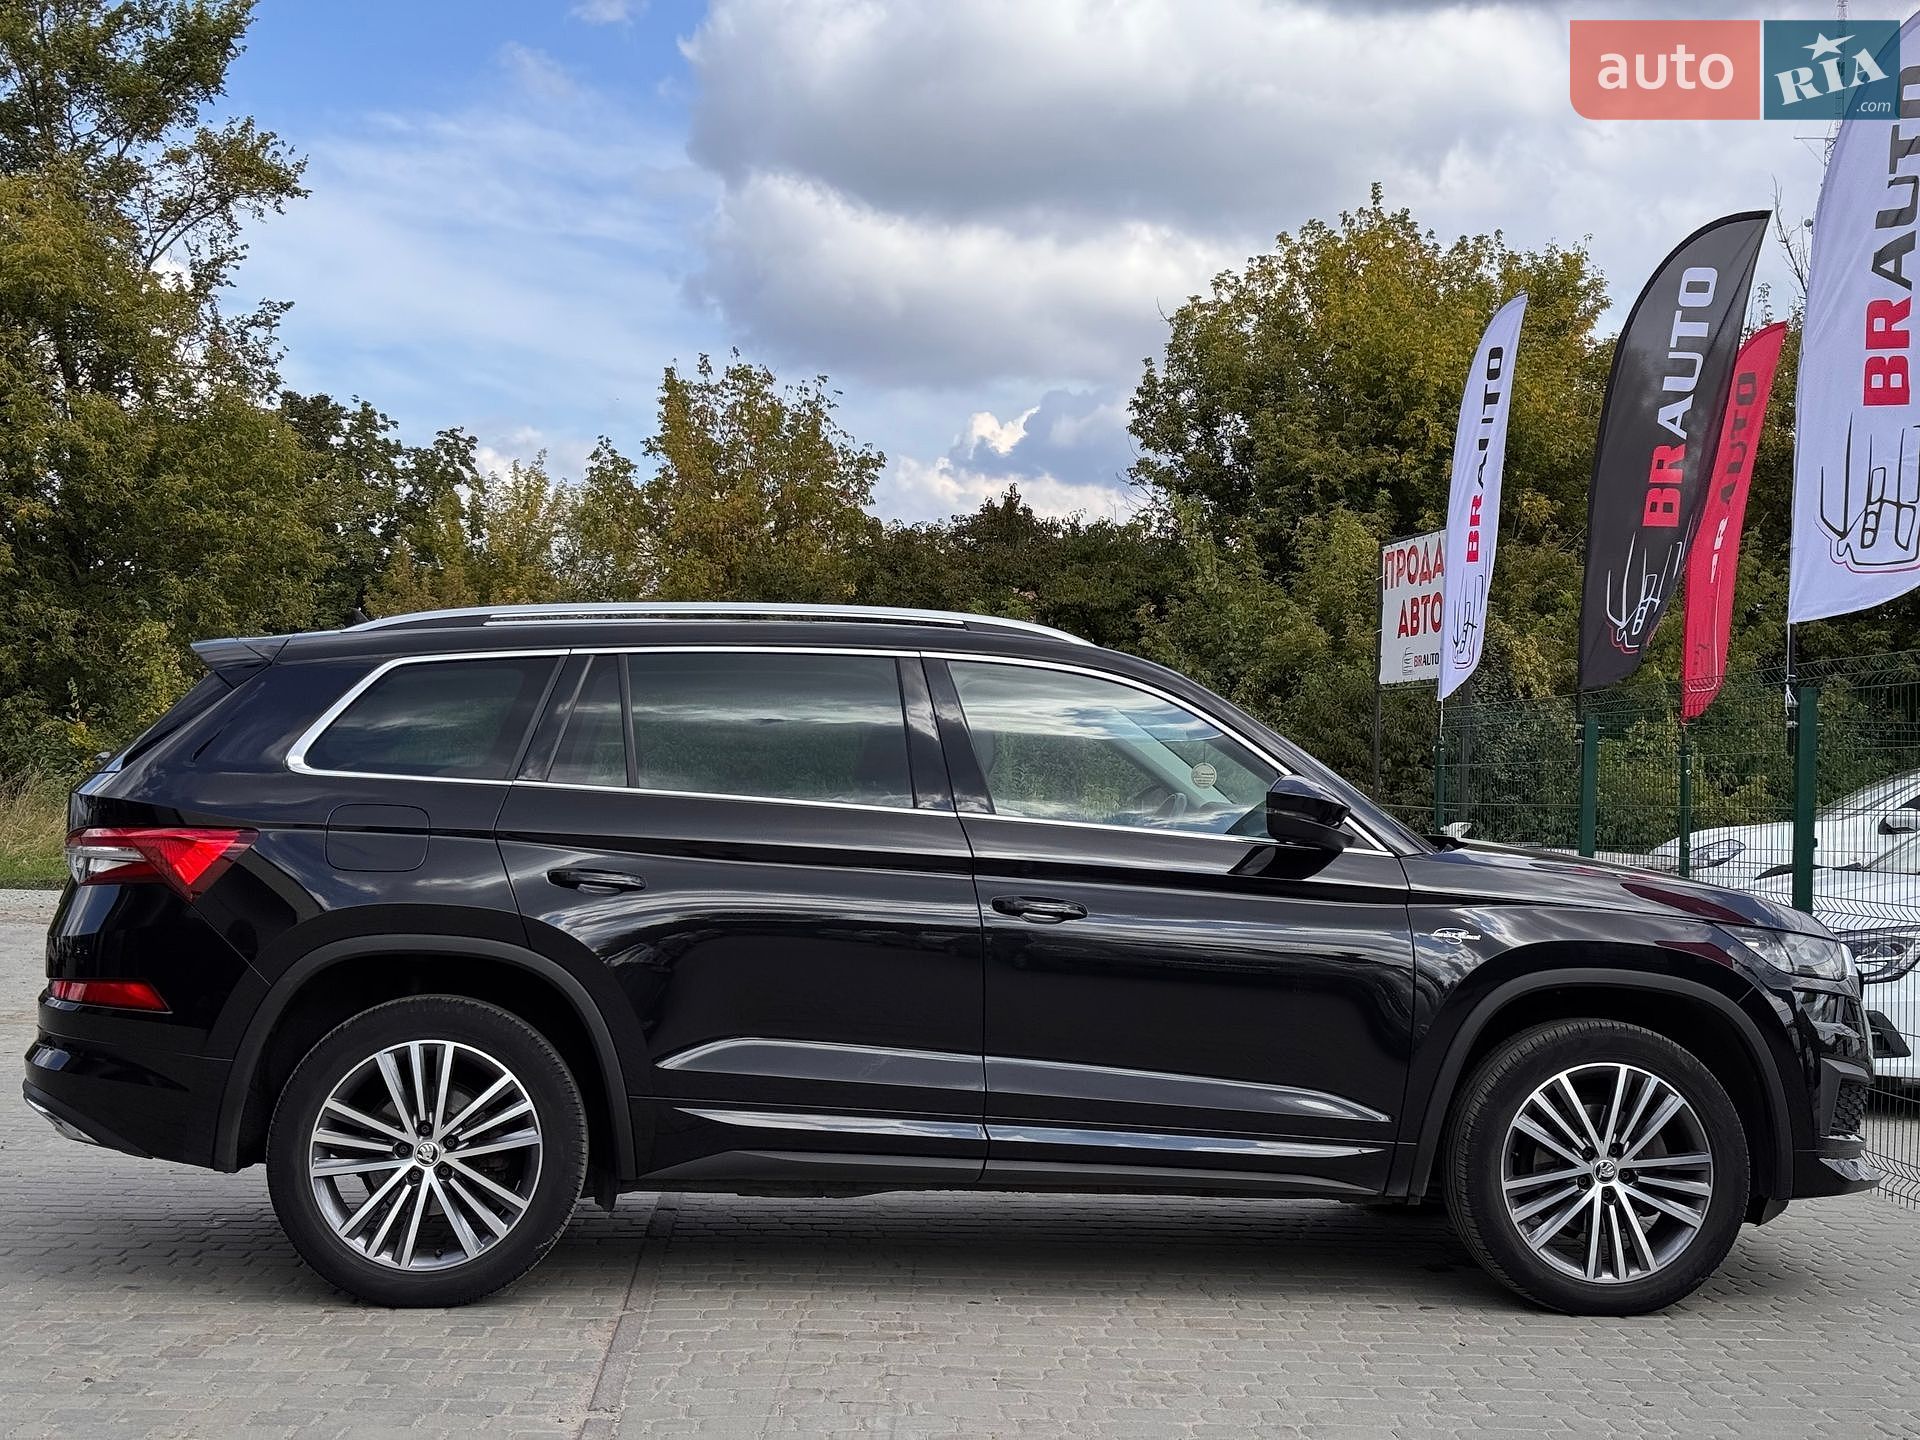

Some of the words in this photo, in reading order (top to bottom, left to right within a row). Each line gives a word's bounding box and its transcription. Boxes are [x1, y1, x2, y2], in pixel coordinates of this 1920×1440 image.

[1642, 267, 1718, 527] BRAUTO
[1397, 592, 1443, 638] АВТО
[1413, 652, 1440, 667] BRAUTO
